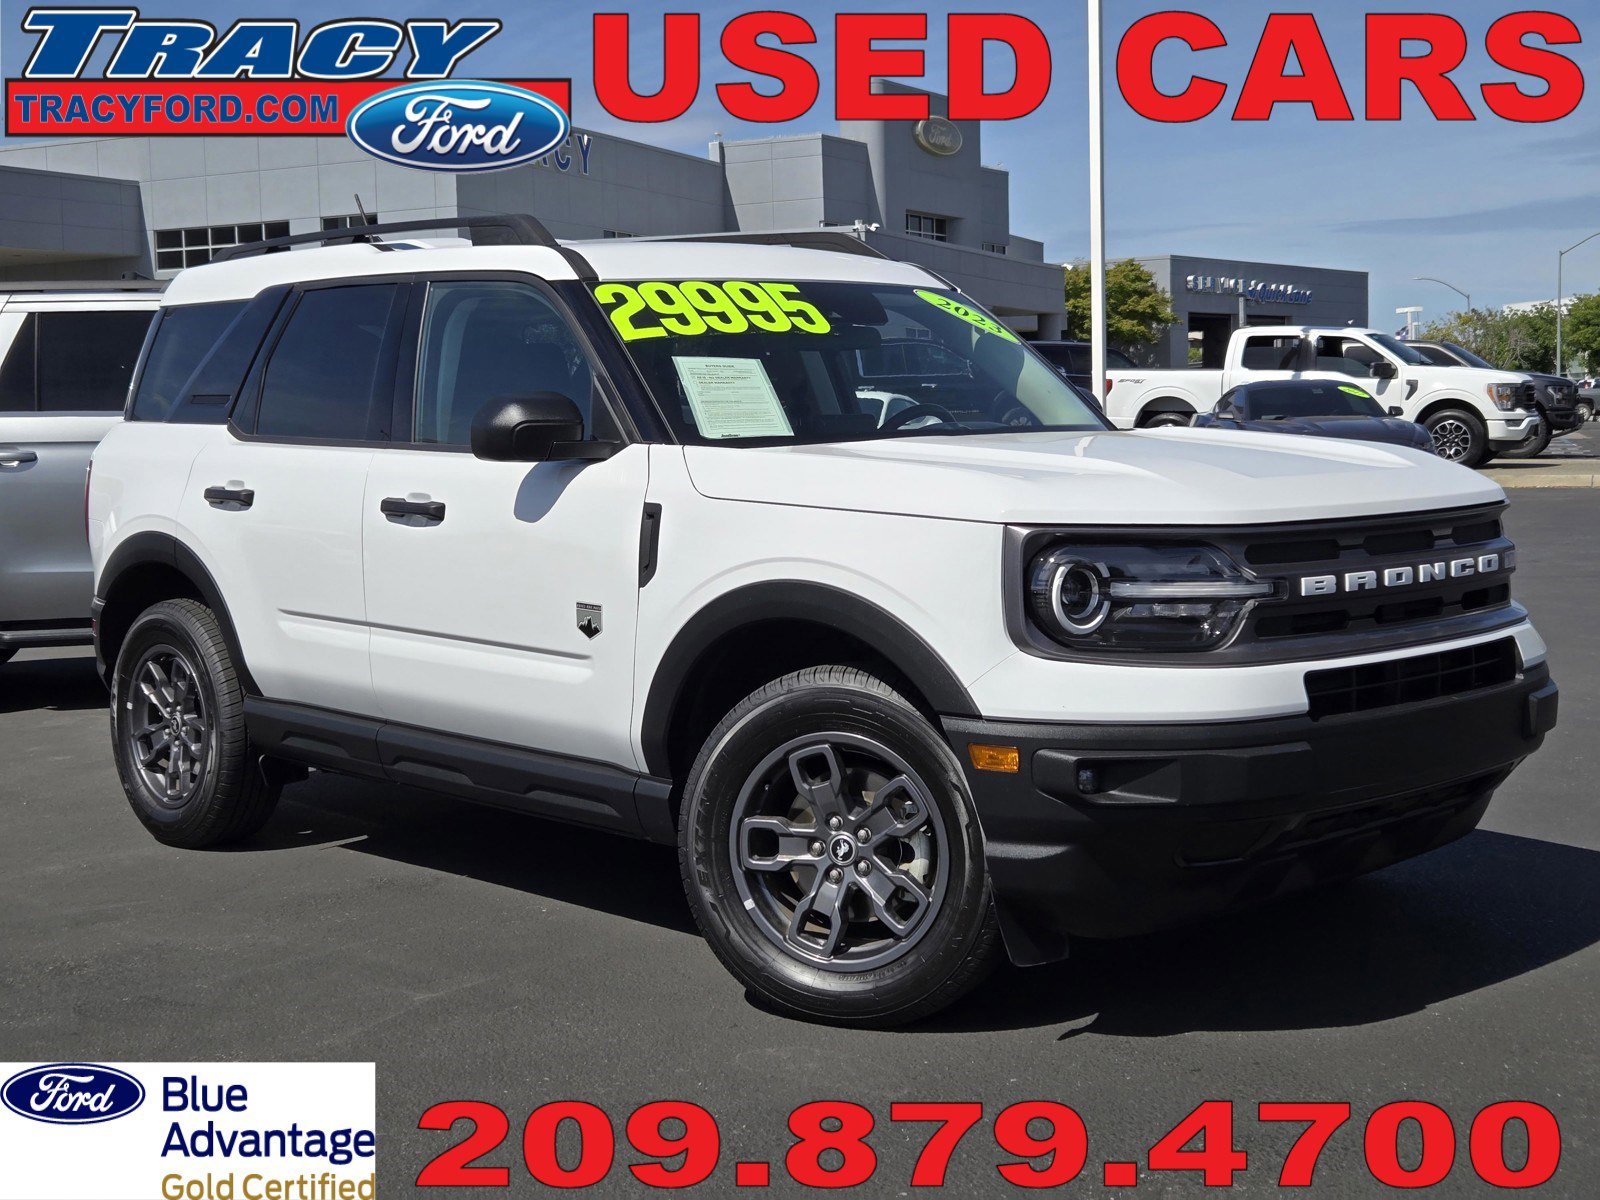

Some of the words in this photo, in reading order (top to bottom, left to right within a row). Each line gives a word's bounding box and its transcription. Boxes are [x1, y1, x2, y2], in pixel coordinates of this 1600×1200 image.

[542, 133, 593, 175] CY
[594, 281, 831, 341] 29995
[937, 297, 1003, 334] 2023
[1300, 553, 1499, 597] BRONCO
